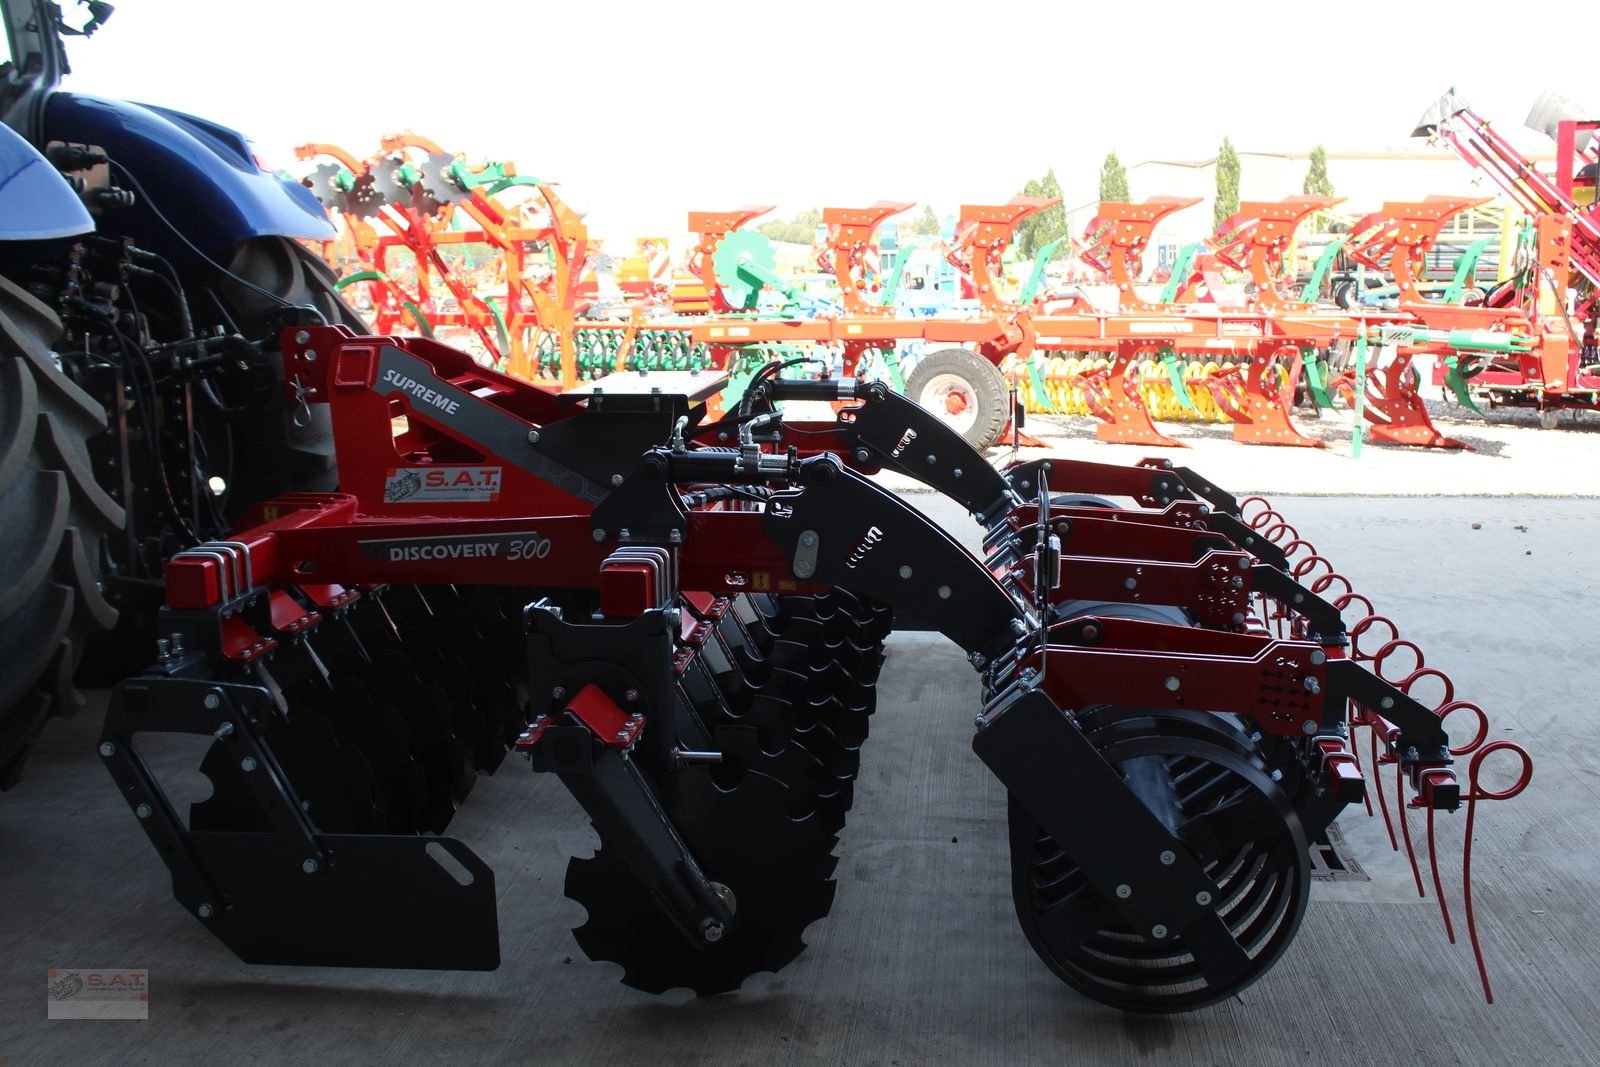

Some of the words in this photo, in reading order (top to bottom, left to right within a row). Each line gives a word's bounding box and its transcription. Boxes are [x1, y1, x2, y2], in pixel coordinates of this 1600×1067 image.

[383, 369, 460, 415] SUPREME
[426, 470, 499, 487] S.A.T.
[390, 543, 499, 562] DISCOVERY
[507, 539, 551, 561] 300
